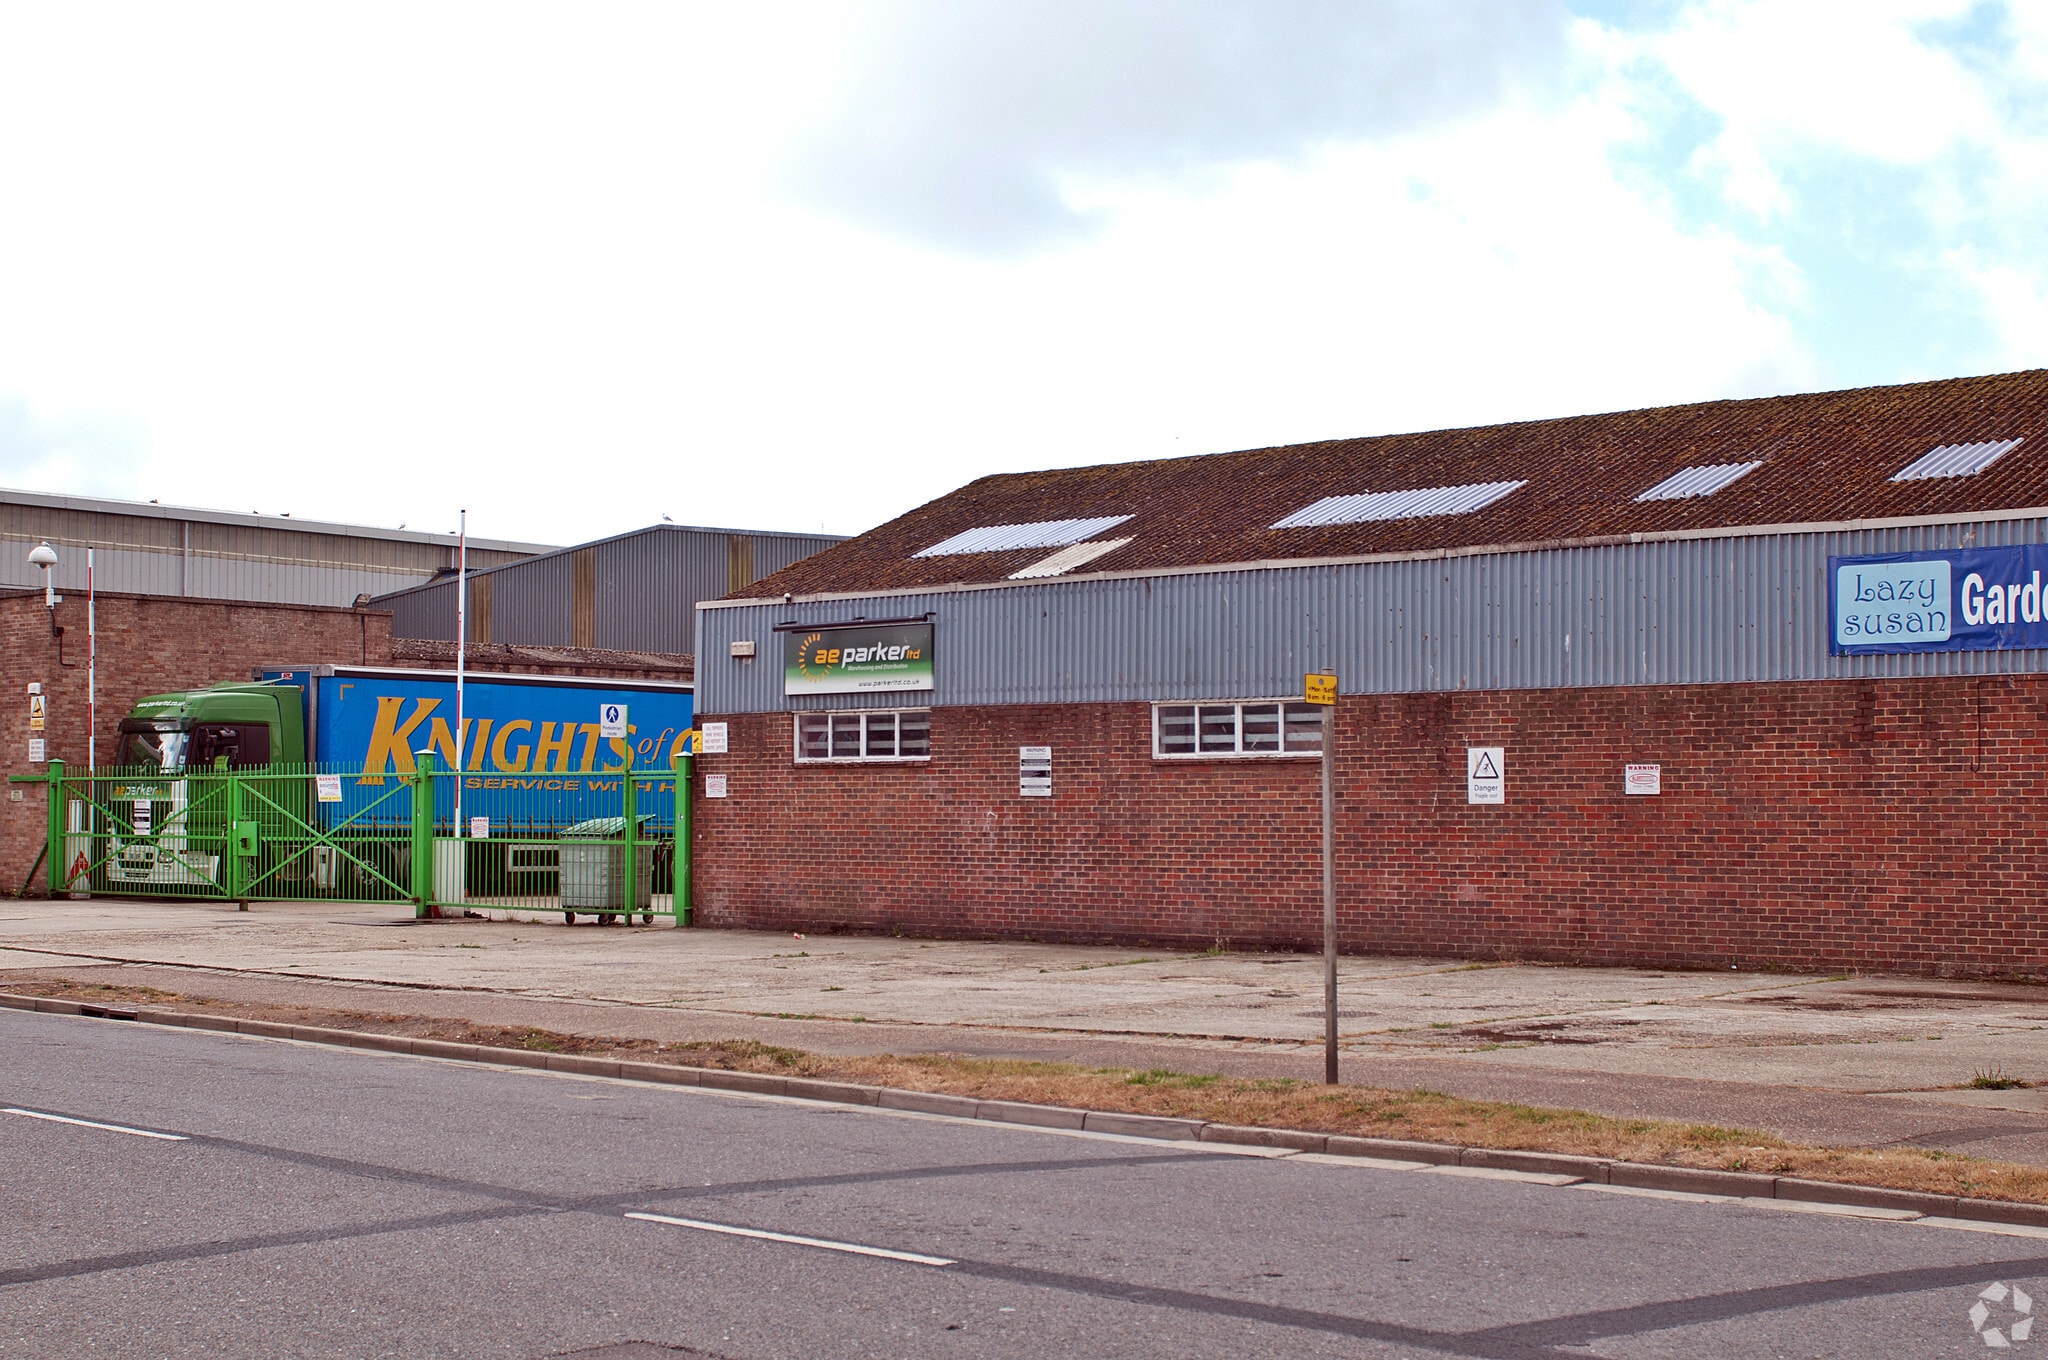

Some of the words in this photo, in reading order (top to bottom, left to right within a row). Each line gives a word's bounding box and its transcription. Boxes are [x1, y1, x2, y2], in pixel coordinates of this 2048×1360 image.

[1854, 574, 1936, 608] Lazy
[1843, 611, 1947, 636] susan
[814, 648, 841, 665] ae
[841, 641, 911, 669] parker
[906, 649, 920, 660] ltd
[858, 679, 920, 687] www.parkerltd.co.uk
[637, 727, 675, 765] of
[464, 777, 581, 791] SERVICE
[1473, 784, 1499, 793] Danger
